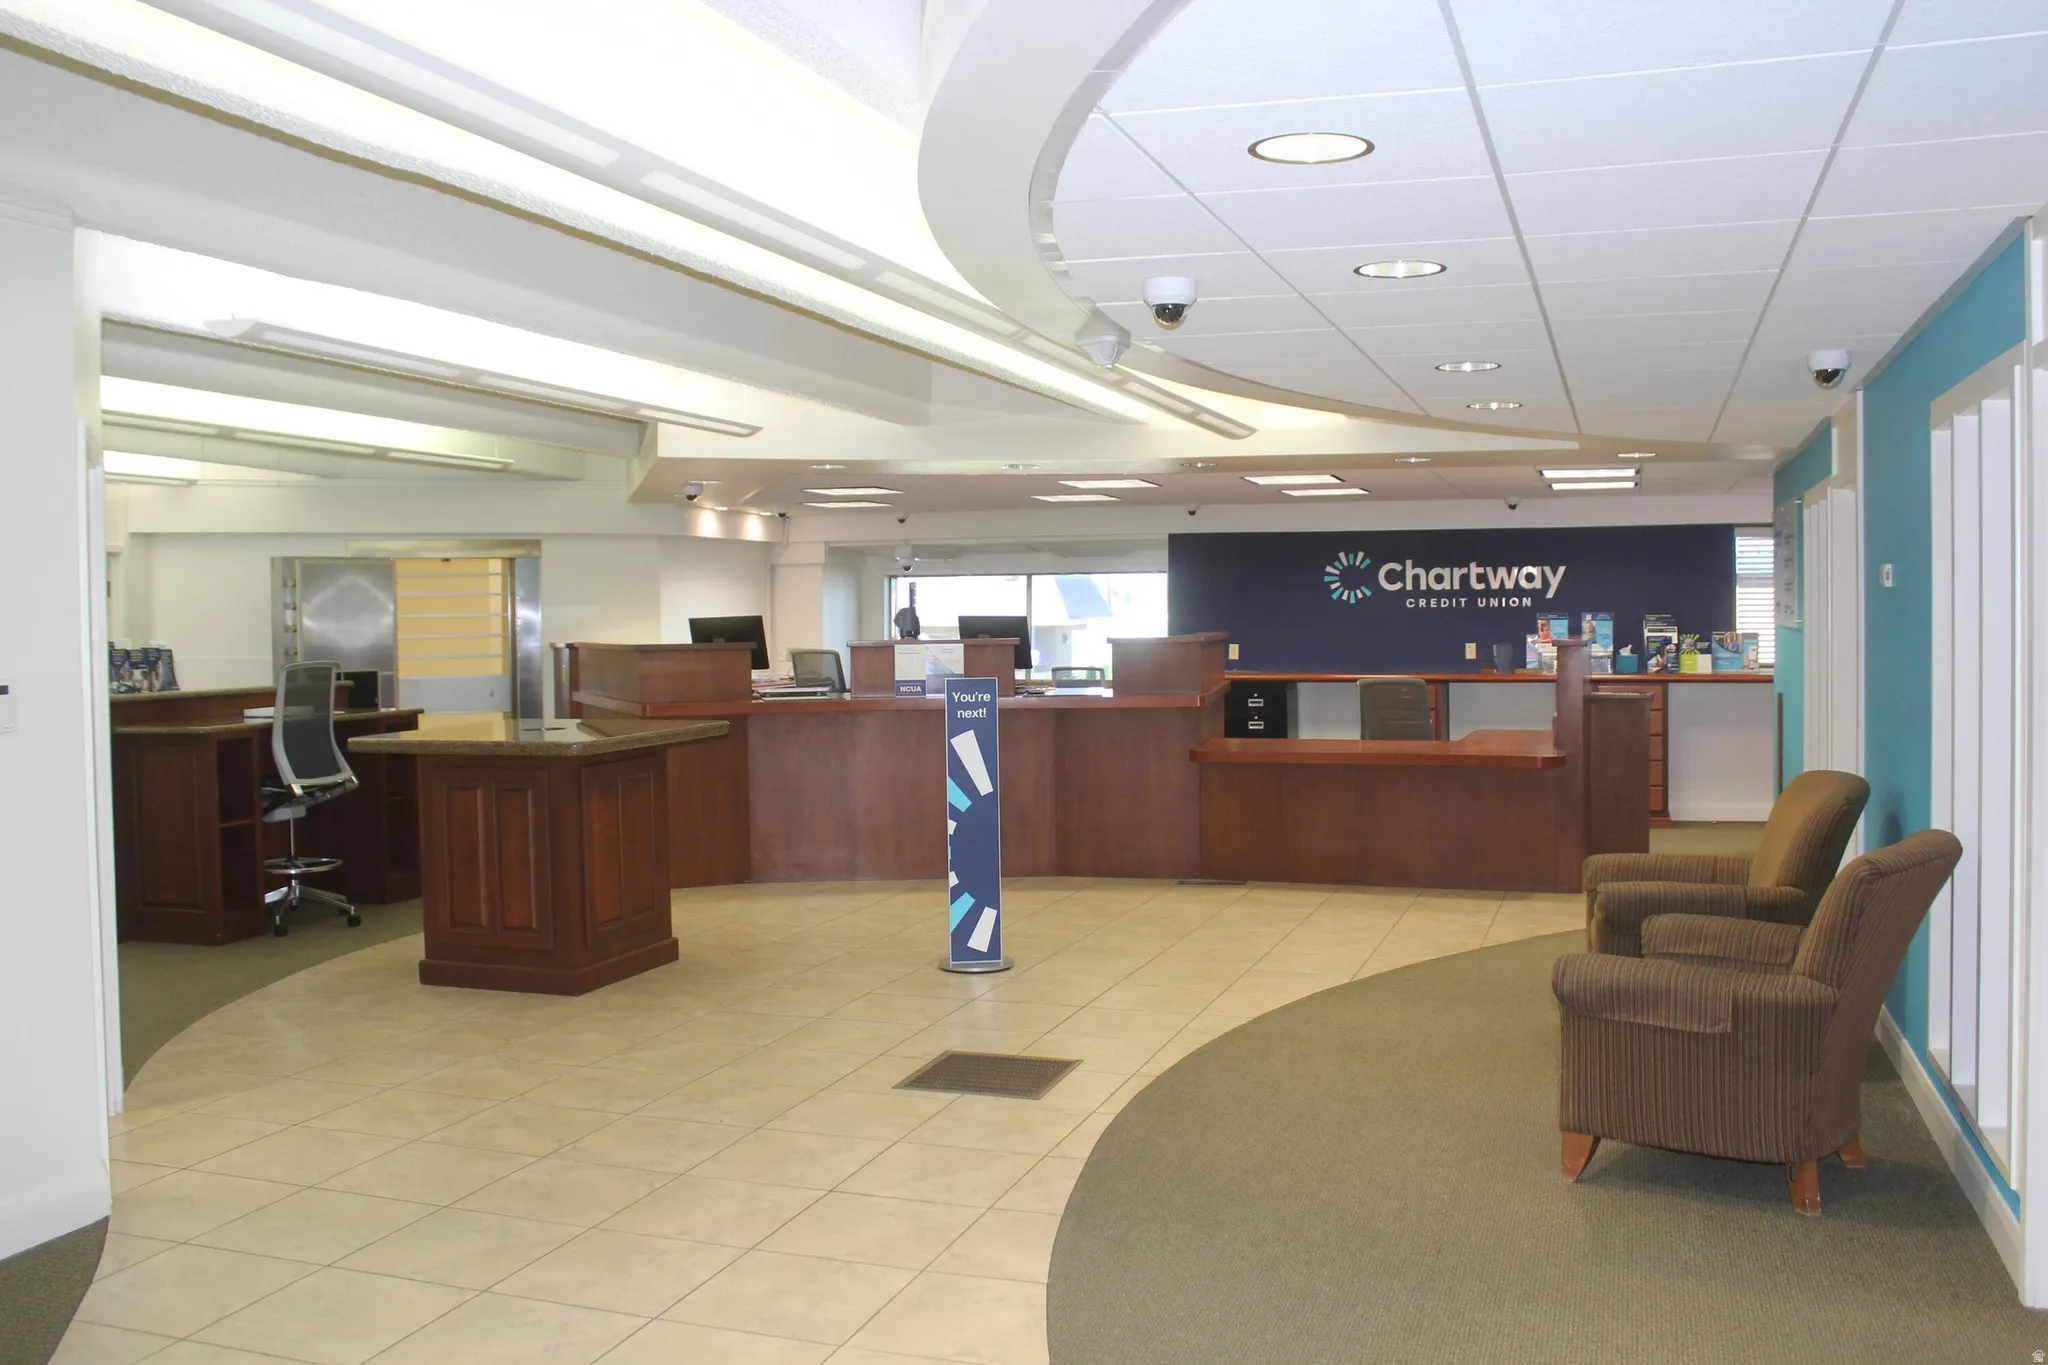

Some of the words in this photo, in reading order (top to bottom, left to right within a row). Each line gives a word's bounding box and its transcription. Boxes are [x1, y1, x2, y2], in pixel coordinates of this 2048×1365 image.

[1377, 559, 1567, 599] Chartway
[1406, 598, 1467, 608] CREDIT
[1477, 597, 1532, 607] UNION
[952, 691, 991, 703] You're
[957, 707, 987, 719] next!
